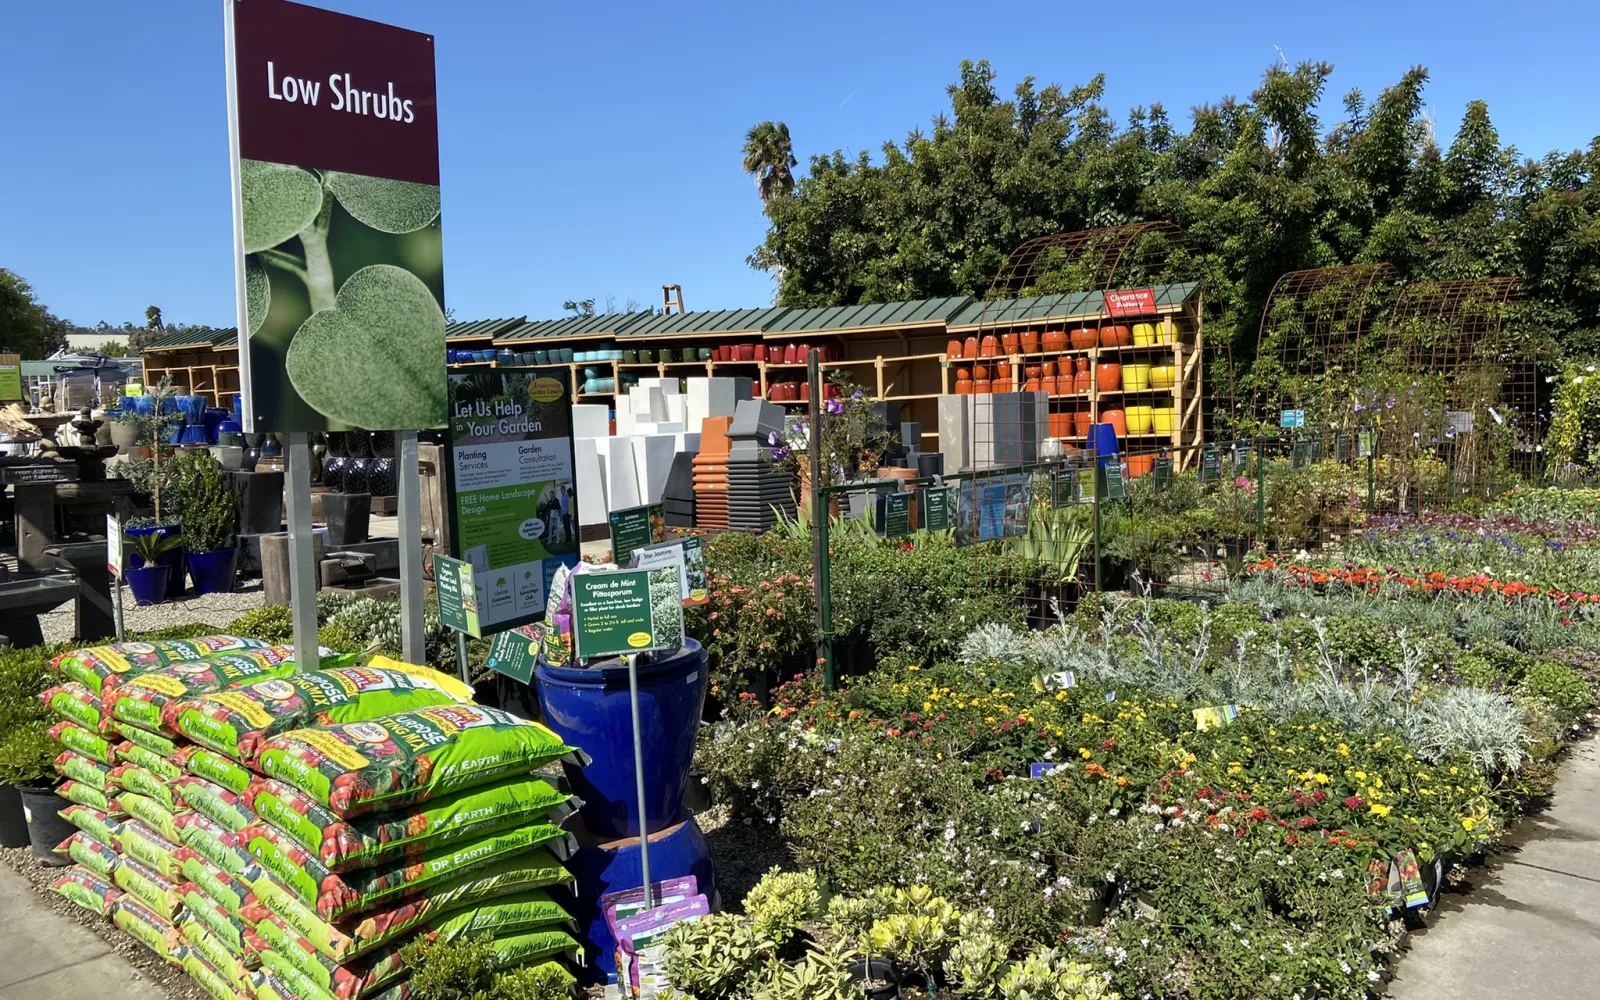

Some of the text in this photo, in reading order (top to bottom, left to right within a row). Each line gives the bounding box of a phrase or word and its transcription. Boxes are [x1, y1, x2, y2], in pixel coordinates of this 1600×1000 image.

[267, 61, 415, 123] Low Shrubs
[1110, 293, 1148, 302] Clearance
[455, 399, 522, 419] Let Us Help
[456, 417, 542, 437] in Your Garden
[458, 450, 487, 461] Planting
[518, 445, 542, 454] Garden
[459, 461, 488, 471] Services
[519, 454, 556, 464] Consultation
[461, 489, 535, 505] FREE Home Landscape
[462, 505, 486, 515] Design
[593, 590, 632, 598] Pittosporum
[310, 688, 330, 706] MIX
[402, 731, 430, 752] MIX
[461, 755, 500, 770] EARTH
[453, 791, 558, 823] EARTH Mother Land
[453, 845, 493, 864] EARTH
[495, 836, 529, 851] Mother
[532, 827, 558, 837] Land
[501, 871, 535, 881] Mother
[267, 894, 292, 922] Mother
[498, 906, 558, 920] Mother Land
[510, 936, 567, 956] Mother Land
